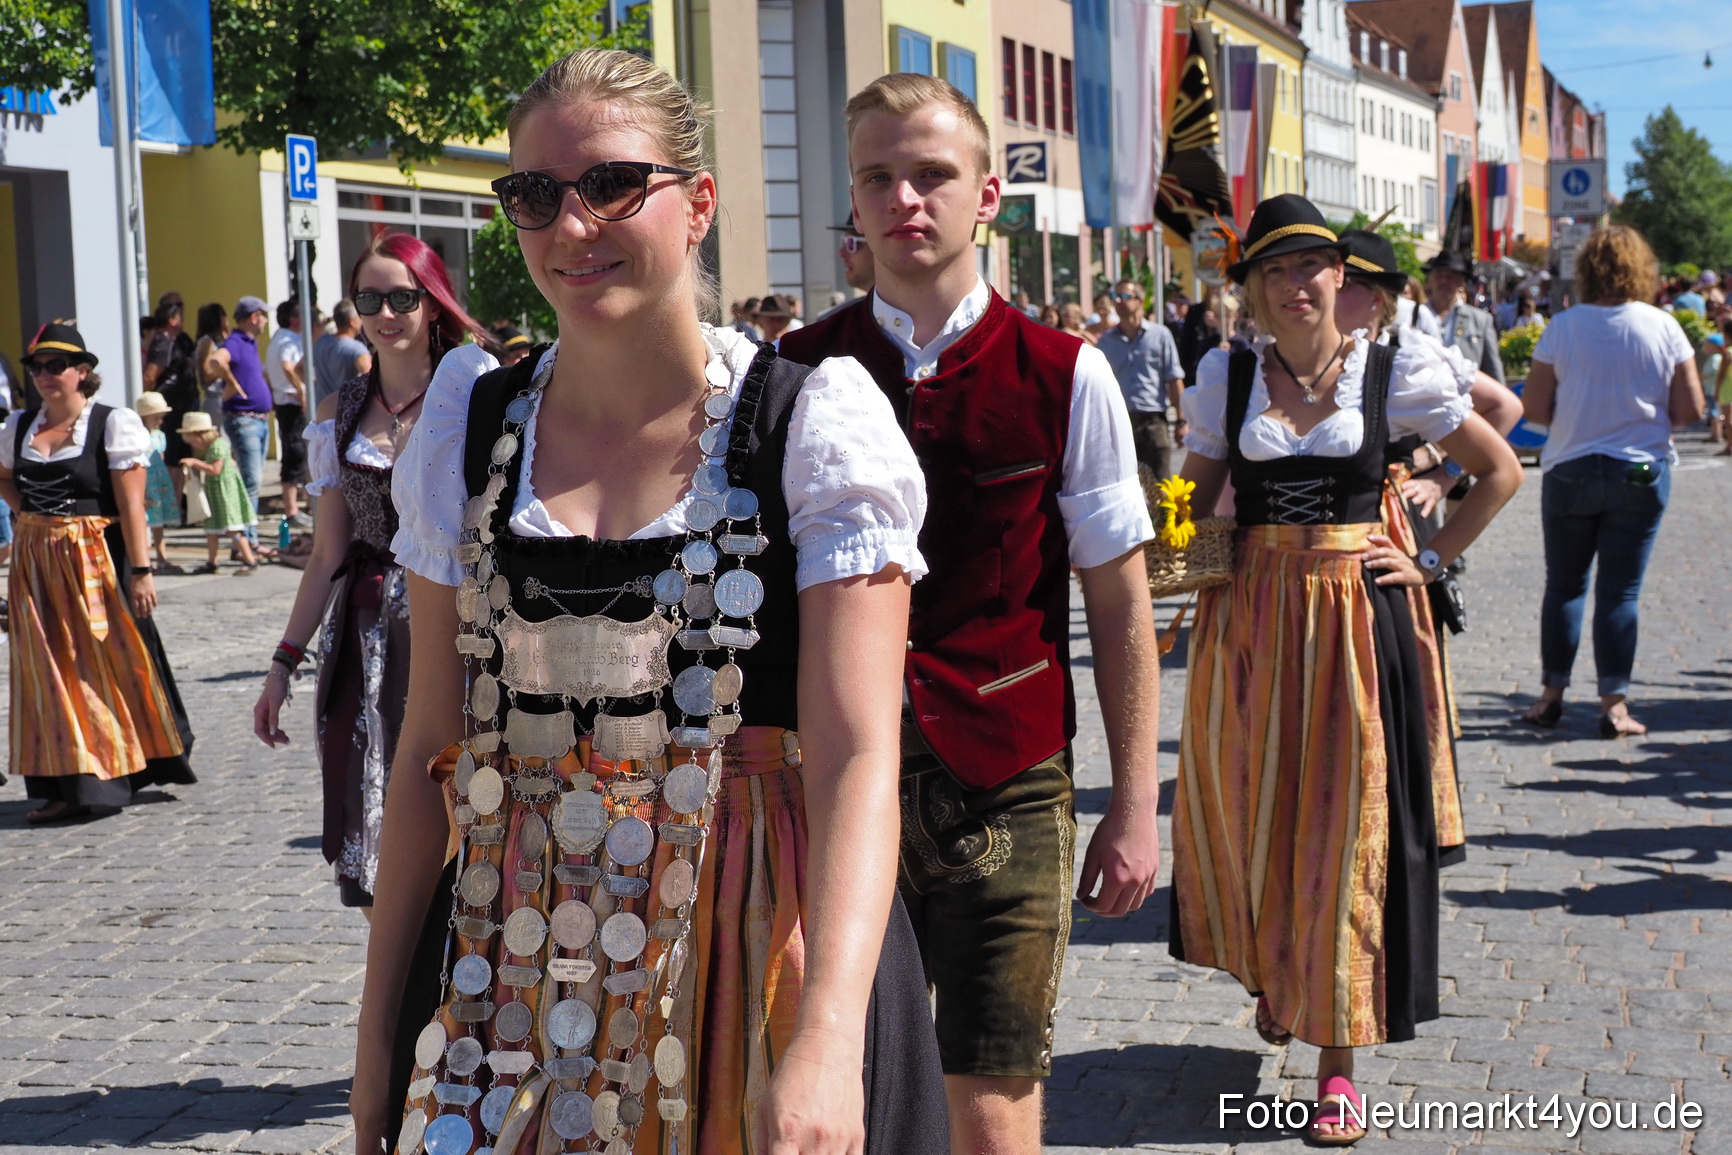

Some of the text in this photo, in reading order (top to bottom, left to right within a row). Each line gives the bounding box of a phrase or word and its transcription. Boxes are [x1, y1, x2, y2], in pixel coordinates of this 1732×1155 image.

[294, 144, 311, 192] P
[1562, 200, 1590, 211] ZONE
[608, 651, 639, 667] Berg
[583, 668, 601, 677] 1926
